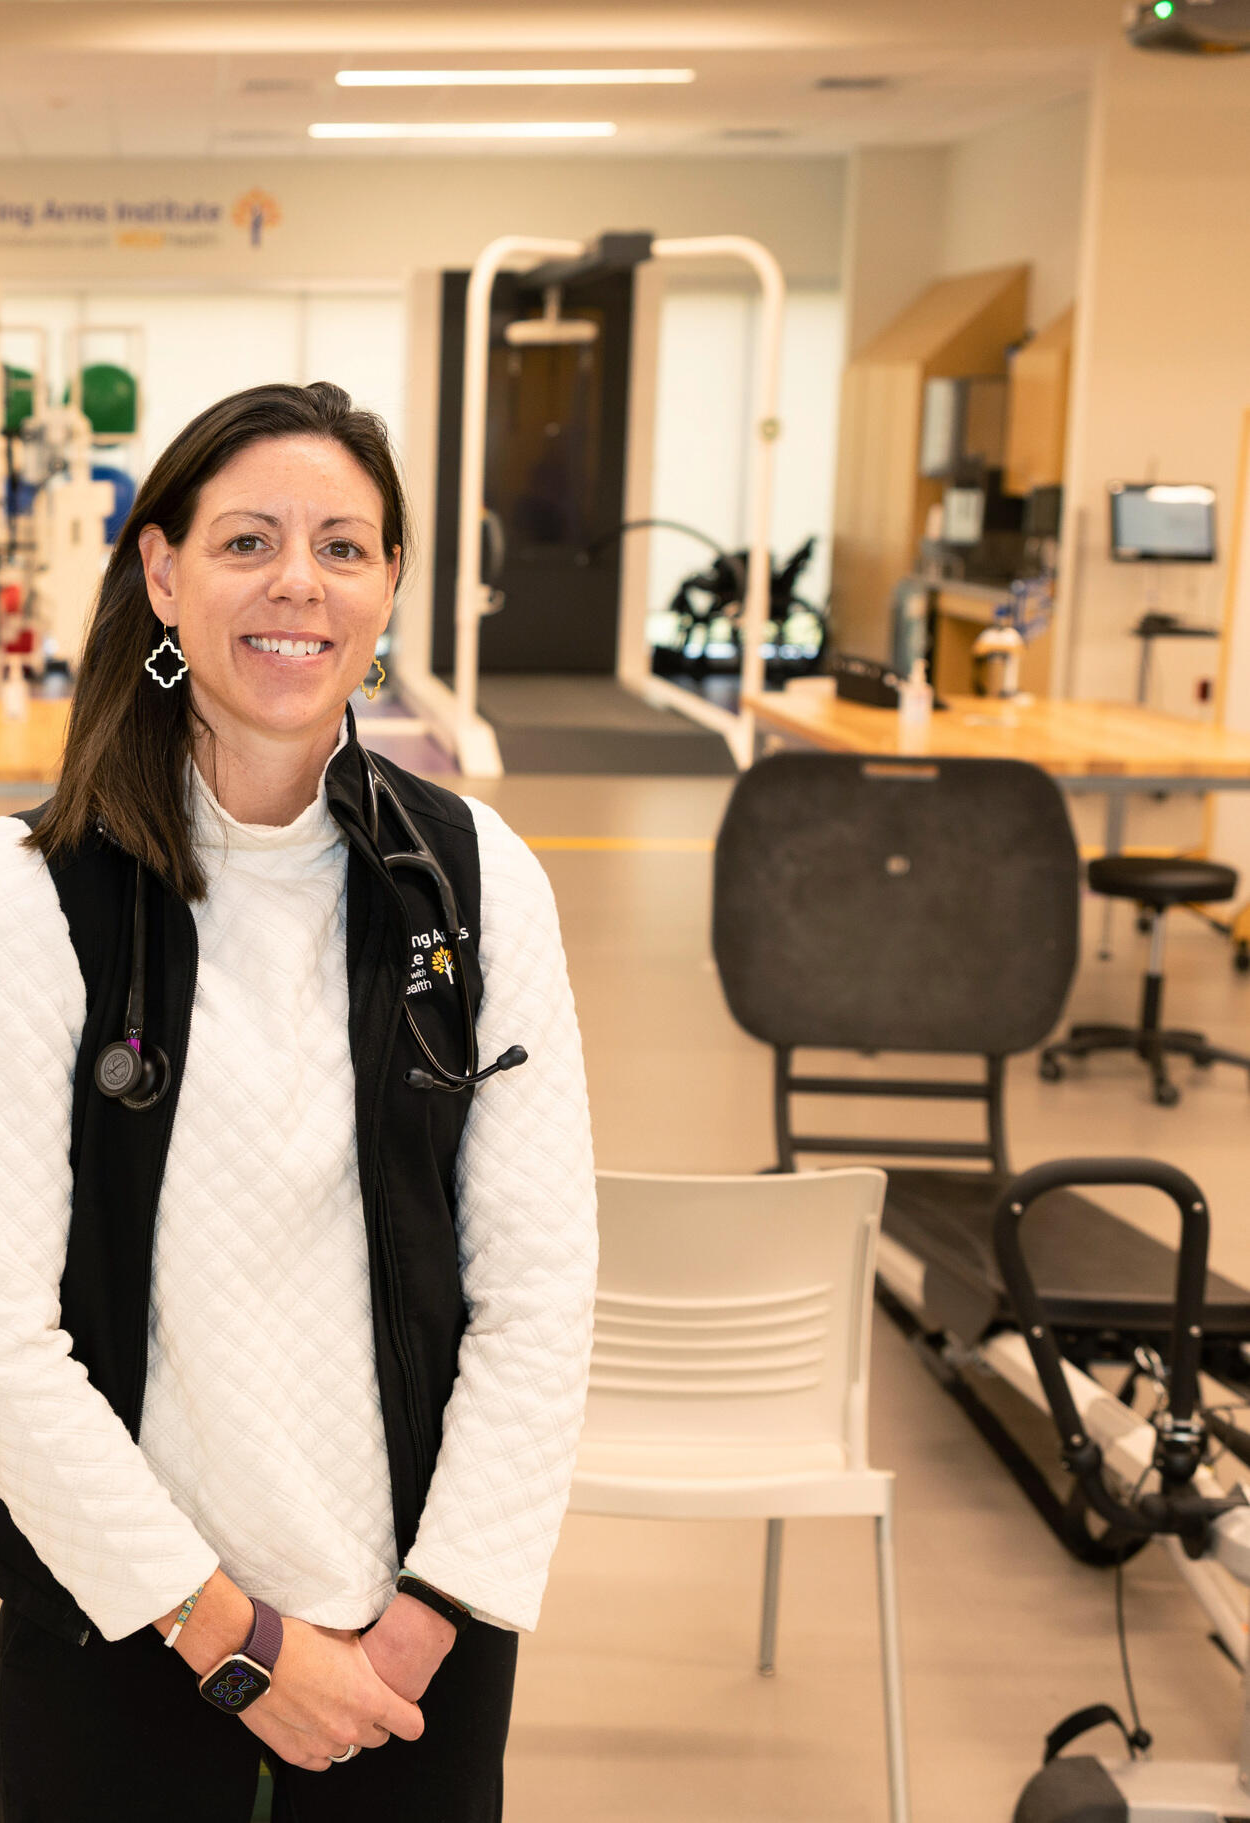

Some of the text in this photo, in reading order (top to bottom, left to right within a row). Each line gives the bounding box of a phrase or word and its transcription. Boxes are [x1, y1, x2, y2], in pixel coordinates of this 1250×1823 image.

[42, 198, 108, 222] Arms
[116, 198, 221, 223] Institute
[432, 927, 469, 944] As
[410, 968, 427, 979] with
[226, 1667, 258, 1691] 42
[212, 1681, 244, 1706] 08
